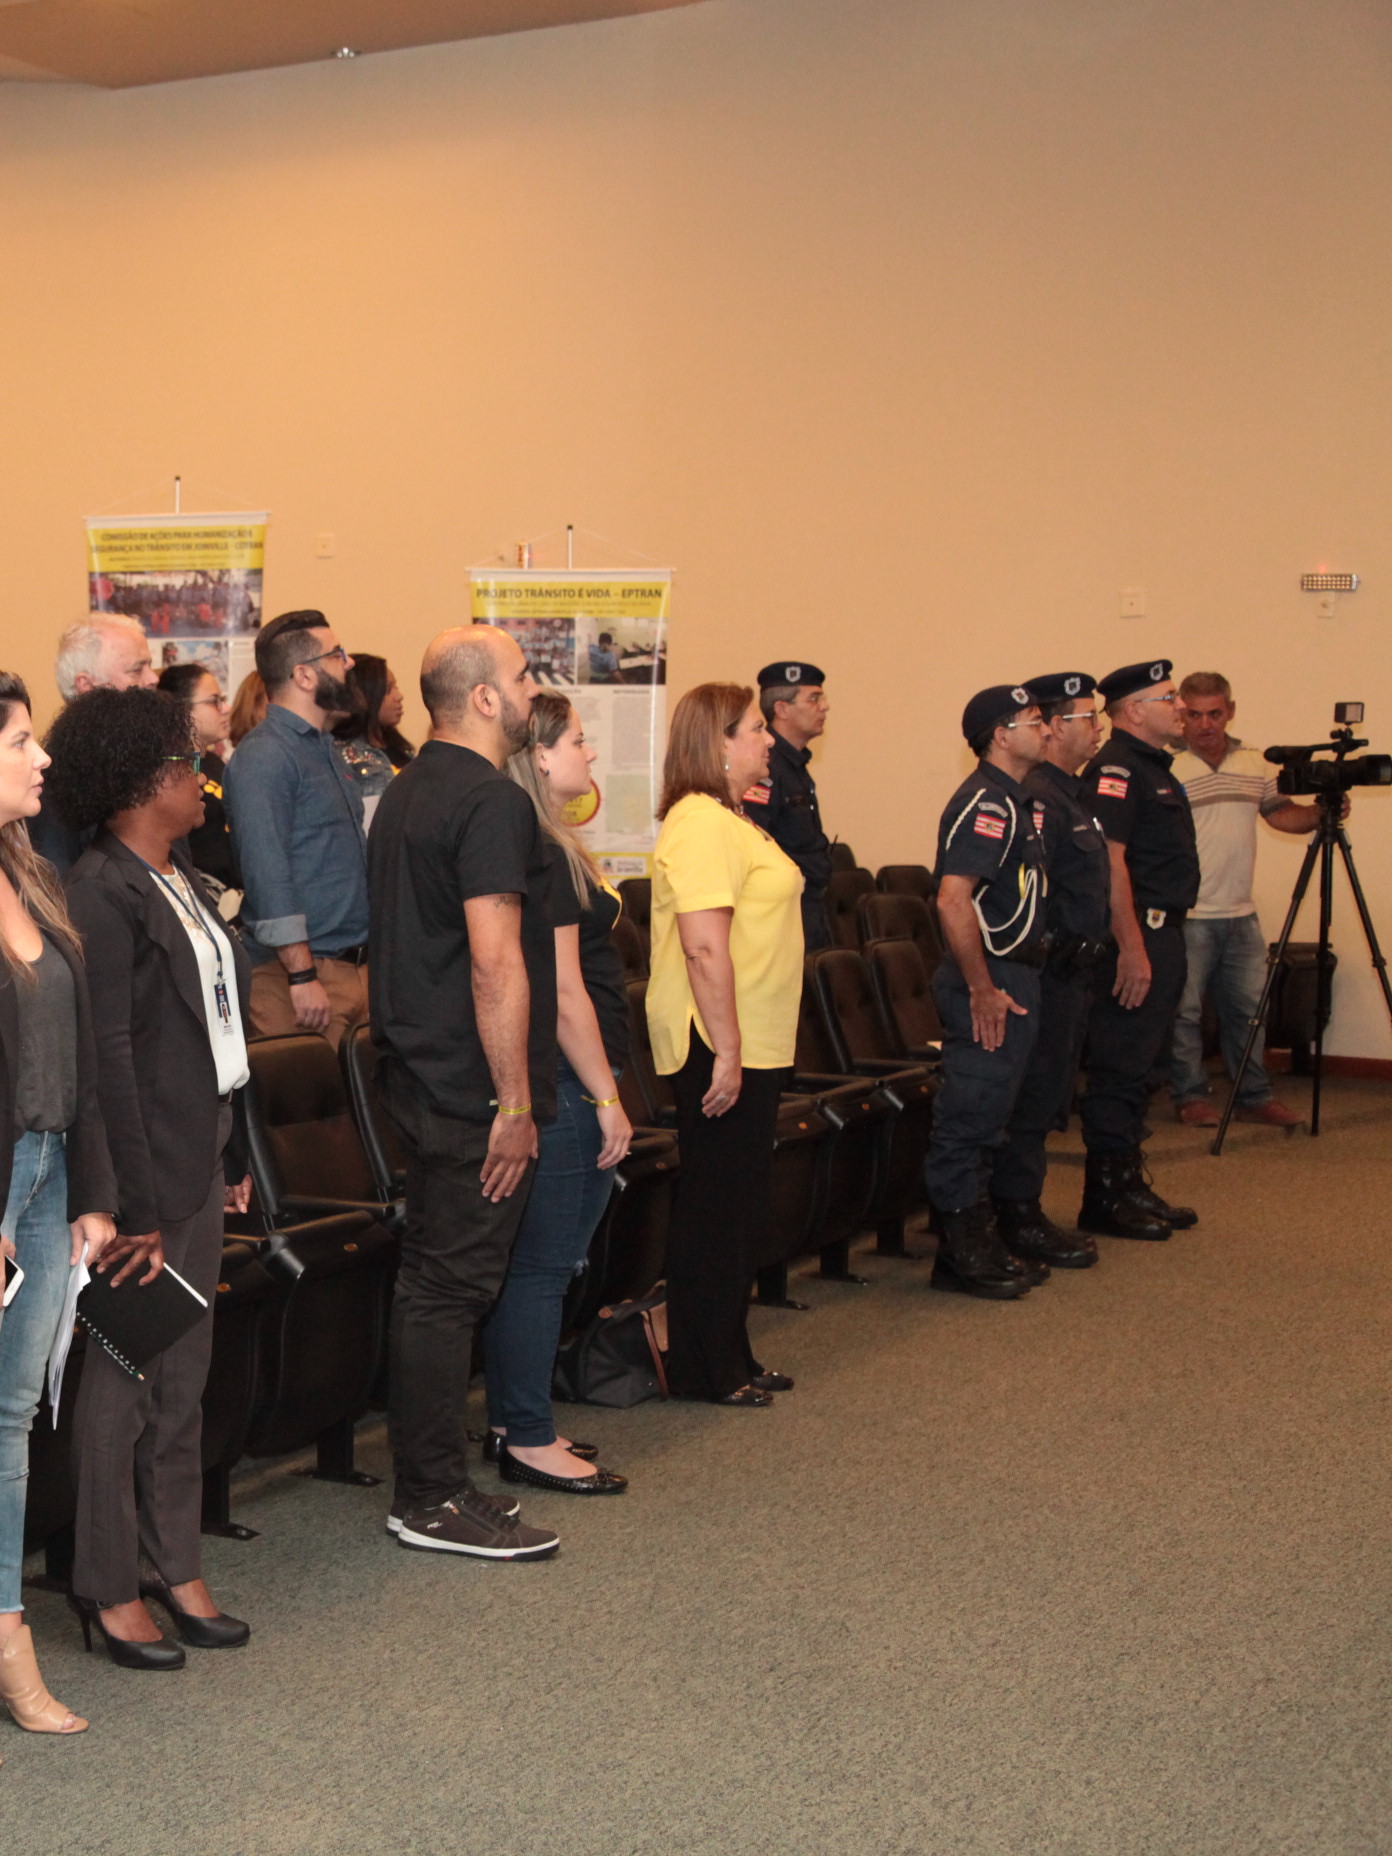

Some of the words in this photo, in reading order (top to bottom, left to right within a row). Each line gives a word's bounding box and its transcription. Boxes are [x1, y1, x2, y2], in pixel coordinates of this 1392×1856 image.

[101, 531, 140, 542] COMISSÃO
[151, 531, 173, 543] AÇÕES
[173, 531, 192, 540] PARA
[193, 529, 249, 540] HUMANIZAÇÃO
[134, 544, 145, 552] NO
[146, 542, 182, 553] TRÂNSITO
[193, 542, 229, 551] JOINVILLE
[475, 588, 522, 599] PROJETO
[525, 586, 576, 599] TRÂNSITO
[578, 586, 584, 599] É
[586, 588, 611, 599] VIDA
[621, 587, 663, 599] EPTRAN
